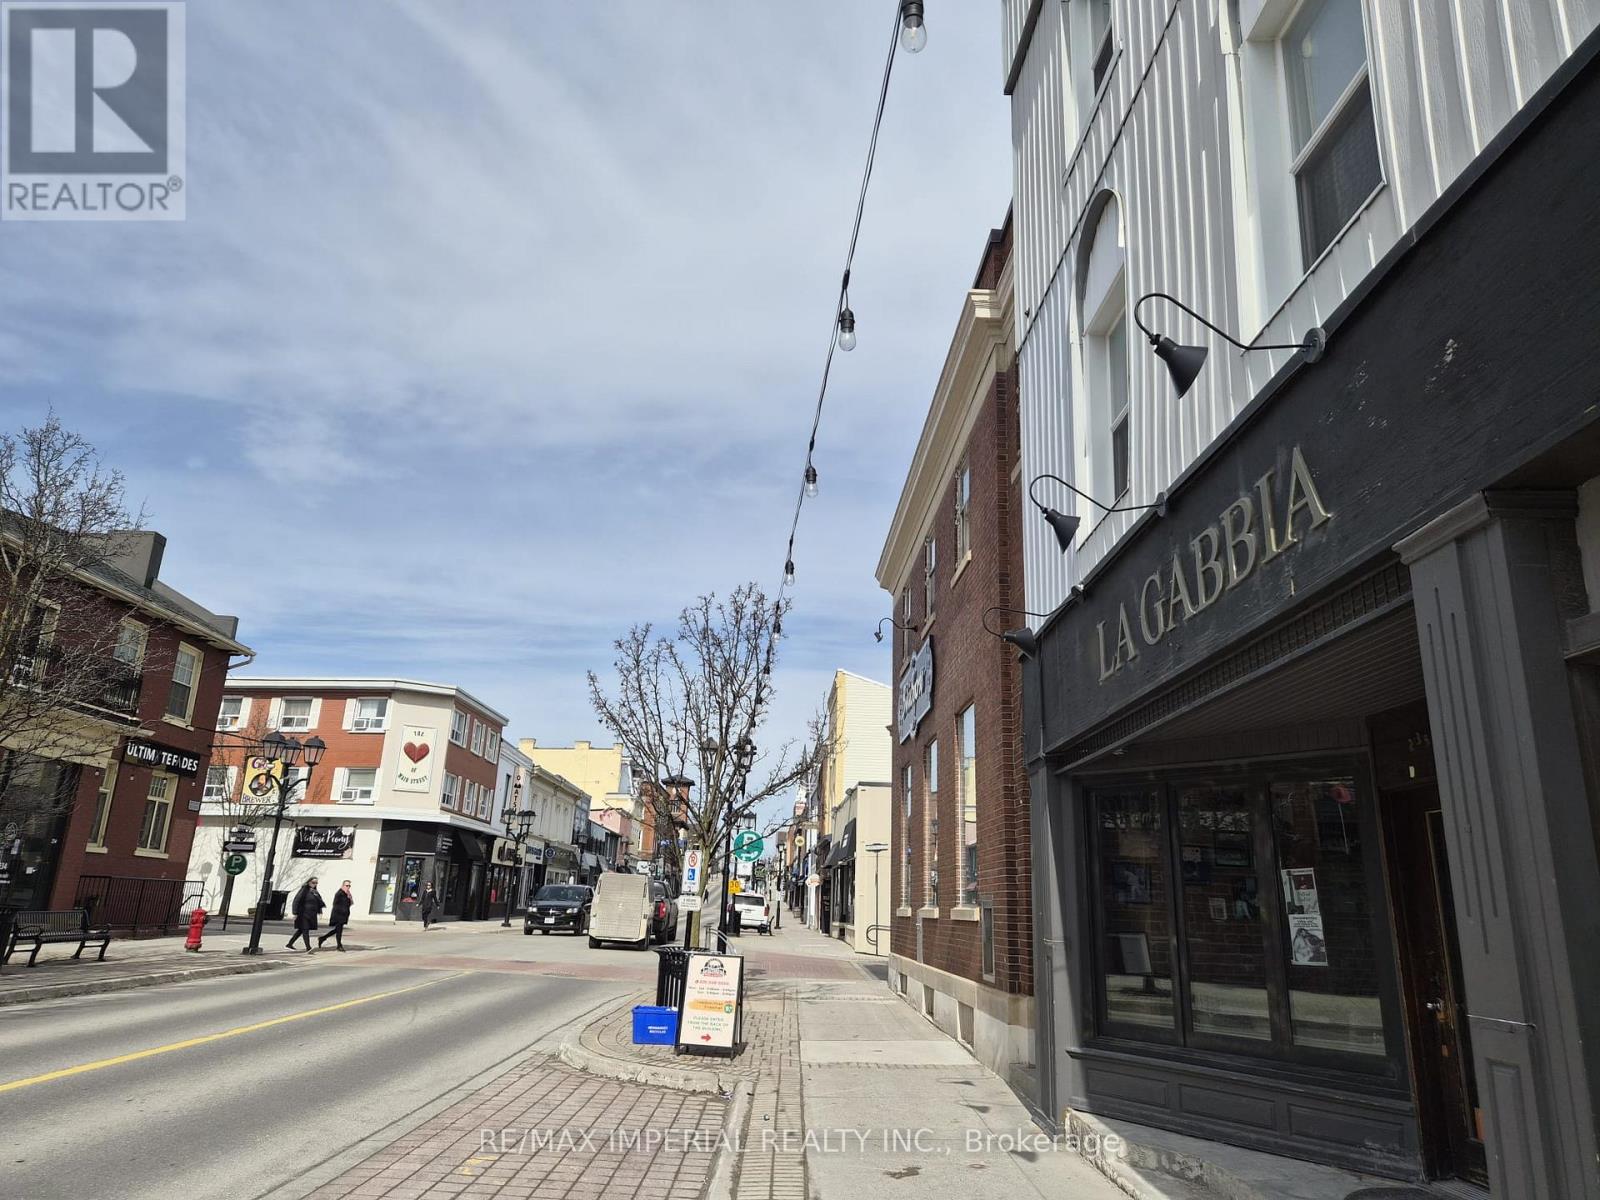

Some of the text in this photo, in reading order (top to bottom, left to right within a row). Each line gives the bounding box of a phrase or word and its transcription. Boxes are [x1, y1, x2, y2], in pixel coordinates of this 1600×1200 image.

[1097, 446, 1334, 683] LA GABBIA
[231, 855, 243, 868] P
